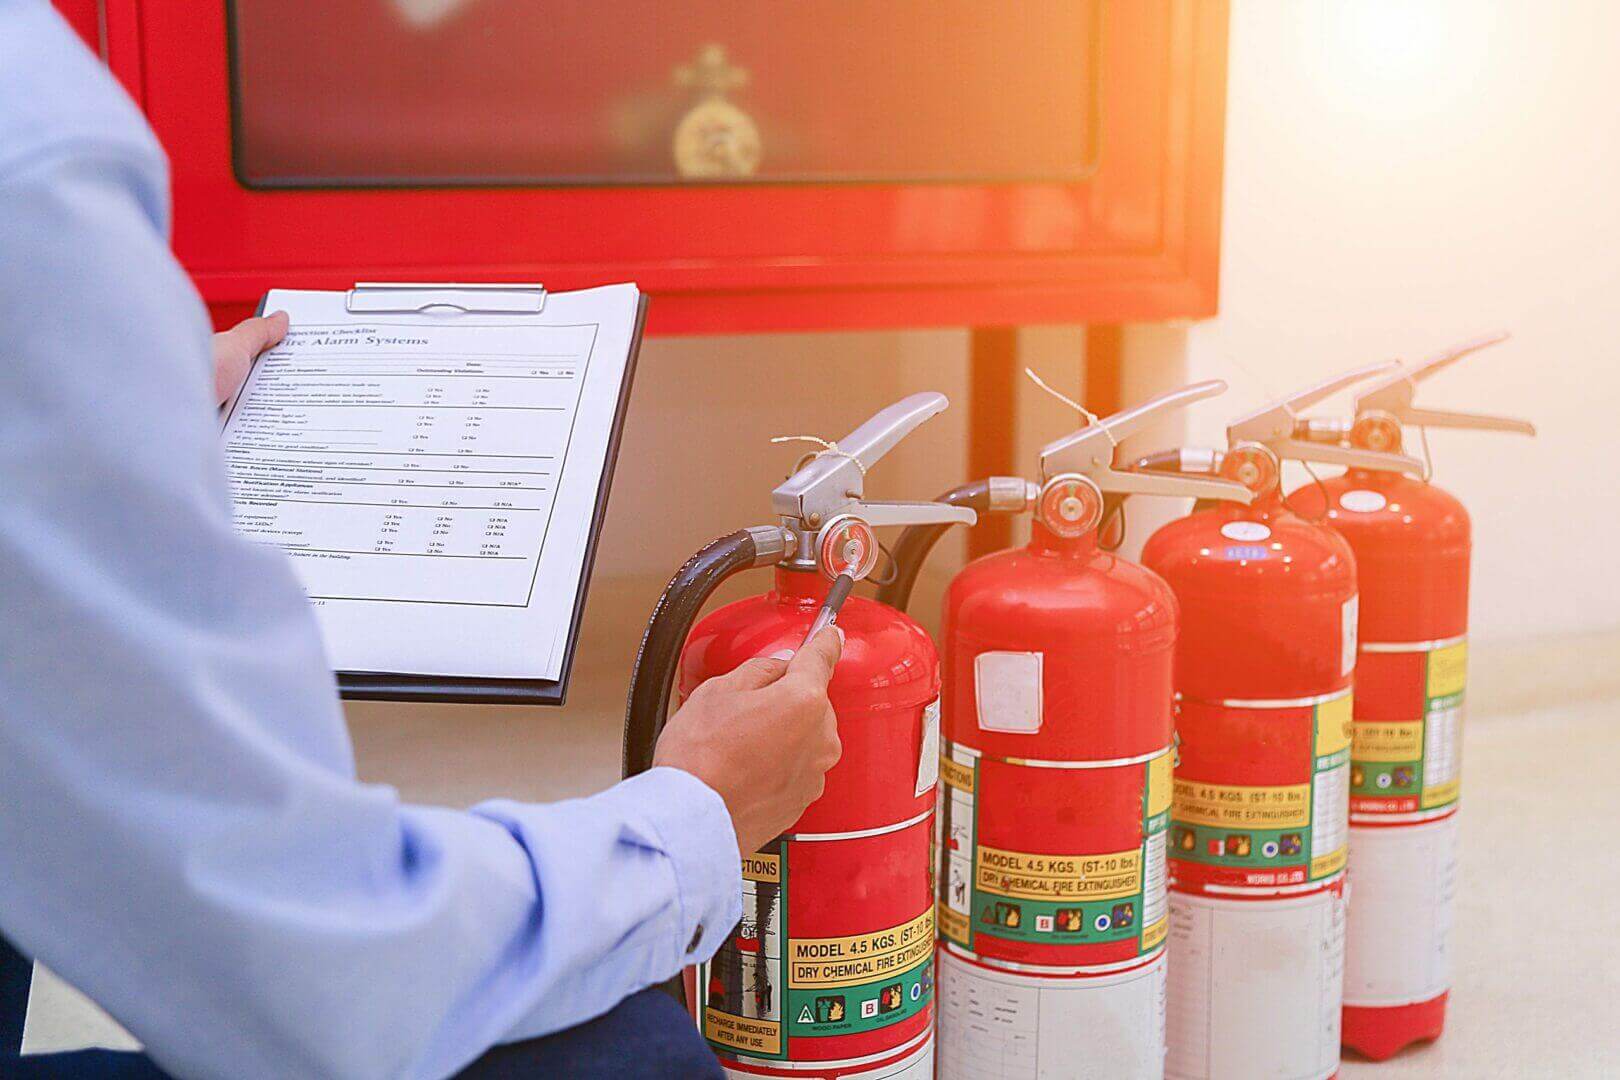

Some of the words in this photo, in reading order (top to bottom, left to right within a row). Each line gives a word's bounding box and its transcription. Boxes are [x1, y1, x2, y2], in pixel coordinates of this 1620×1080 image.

[311, 337, 358, 347] Alarm
[365, 336, 429, 347] Systems
[982, 852, 1022, 870] MODEL
[1027, 861, 1044, 872] 4.5
[1082, 859, 1117, 875] (ST-10
[982, 871, 999, 882] DRY
[1053, 881, 1074, 892] FIRE
[1077, 875, 1137, 892] EXTINGUISHER
[796, 943, 845, 958] MODEL
[849, 940, 868, 955] 4.5
[871, 934, 897, 952] KGS.
[900, 920, 924, 946] (ST-10
[797, 966, 819, 979] DRY
[822, 960, 874, 979] CHEMICAL
[876, 956, 896, 972] FIRE
[865, 1003, 875, 1015] B
[706, 1012, 735, 1030] RECHARGE
[736, 1022, 777, 1037] IMMEDIATELY
[717, 1030, 735, 1042] AFTER
[736, 1034, 749, 1045] ANY
[750, 1038, 763, 1048] USE
